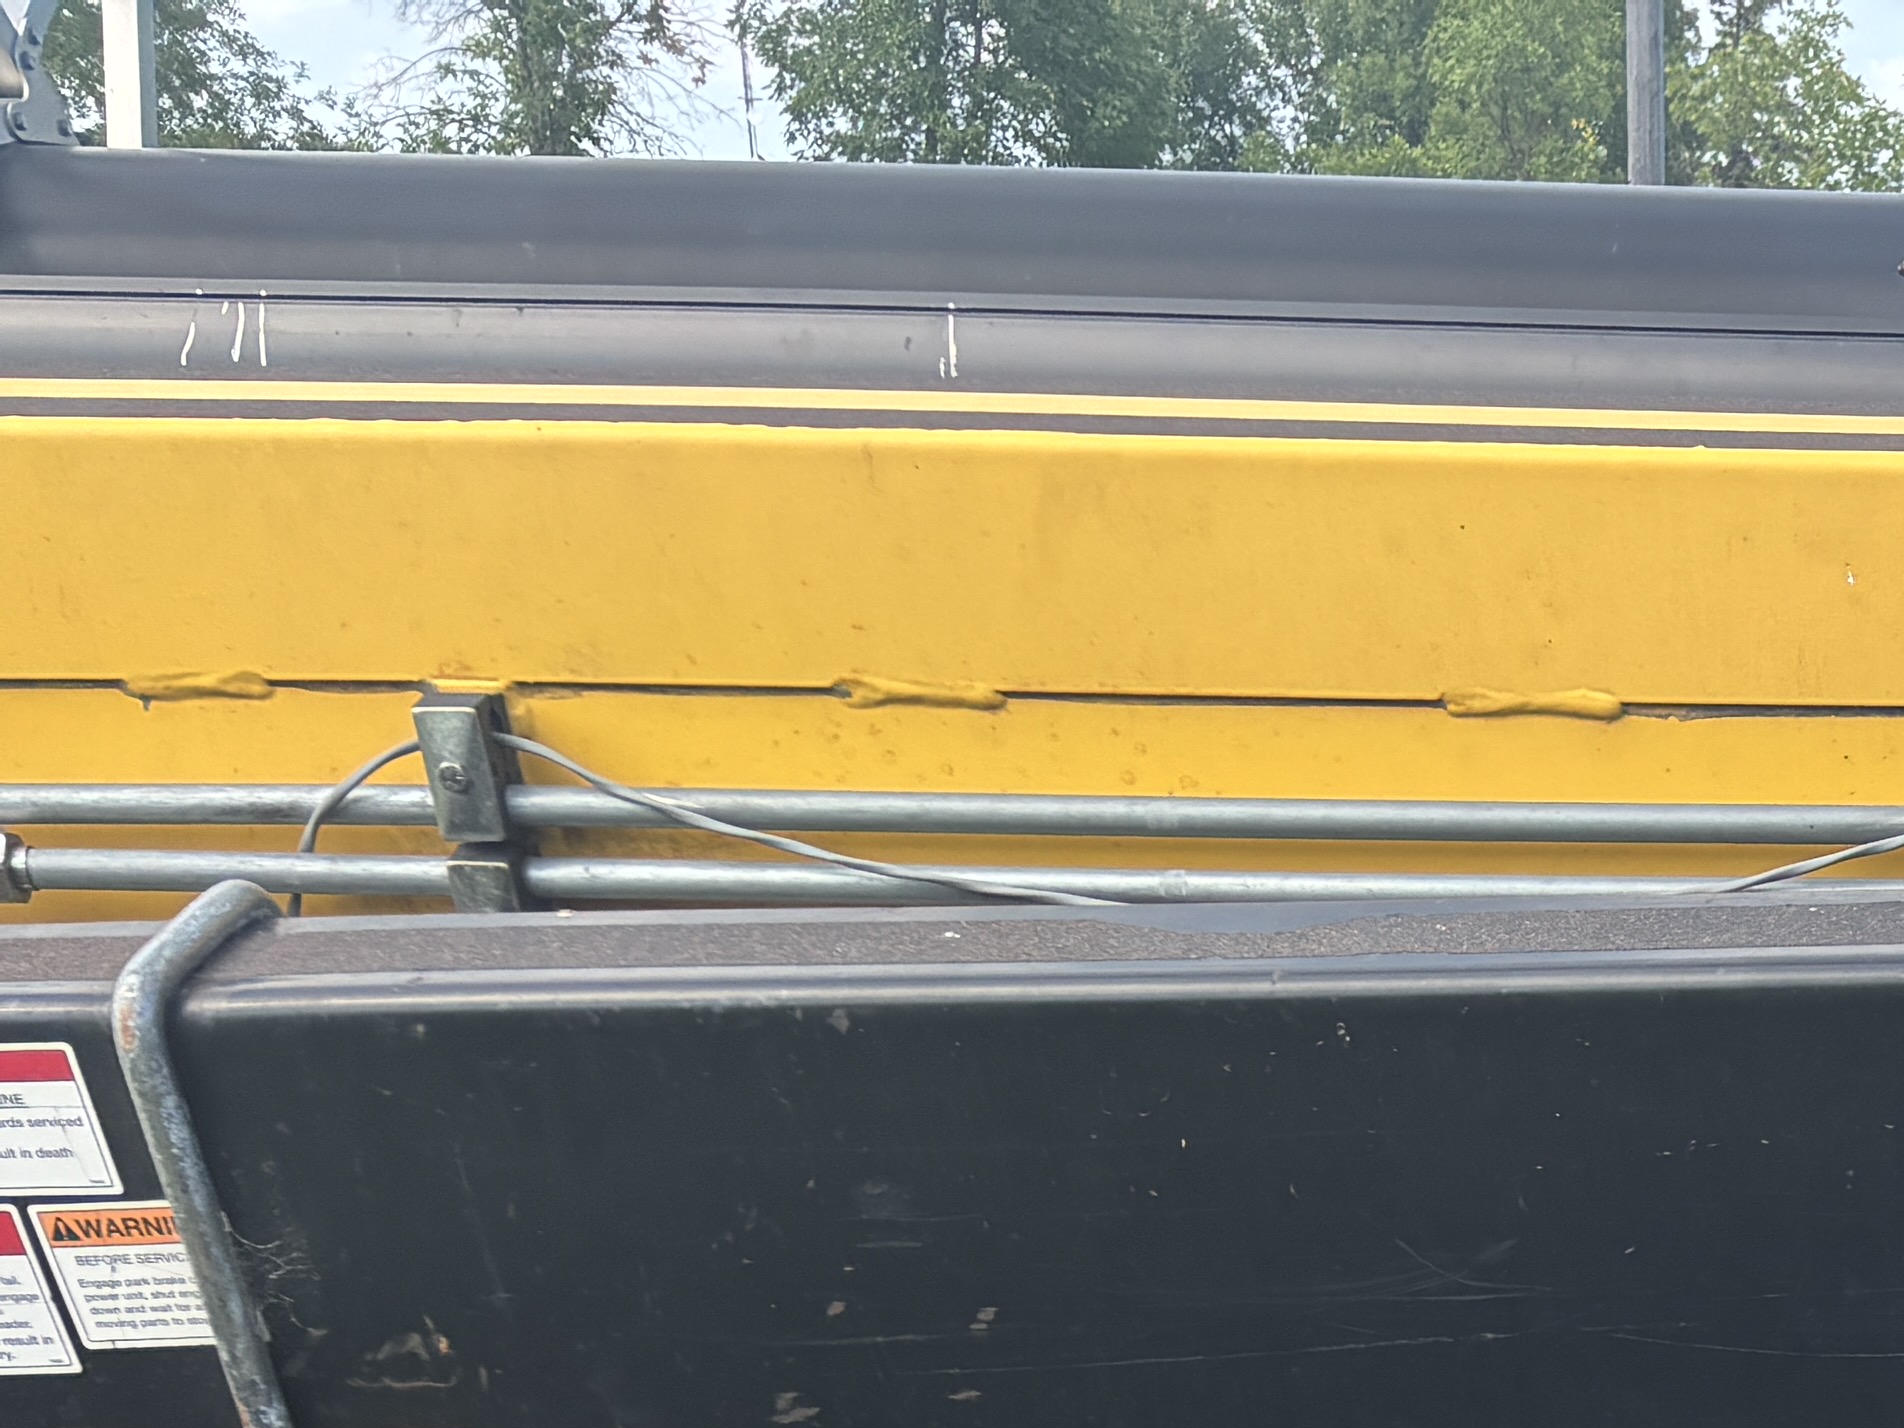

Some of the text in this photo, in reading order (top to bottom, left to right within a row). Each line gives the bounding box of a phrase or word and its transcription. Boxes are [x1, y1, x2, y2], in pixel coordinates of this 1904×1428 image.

[27, 1115, 84, 1127] serviced
[35, 1147, 74, 1159] death
[74, 1216, 178, 1238] WARNI
[74, 1251, 186, 1267] BEFORE SERVIC
[77, 1278, 122, 1289] Engage
[84, 1292, 119, 1303] power
[89, 1306, 122, 1315] down
[124, 1305, 147, 1314] and
